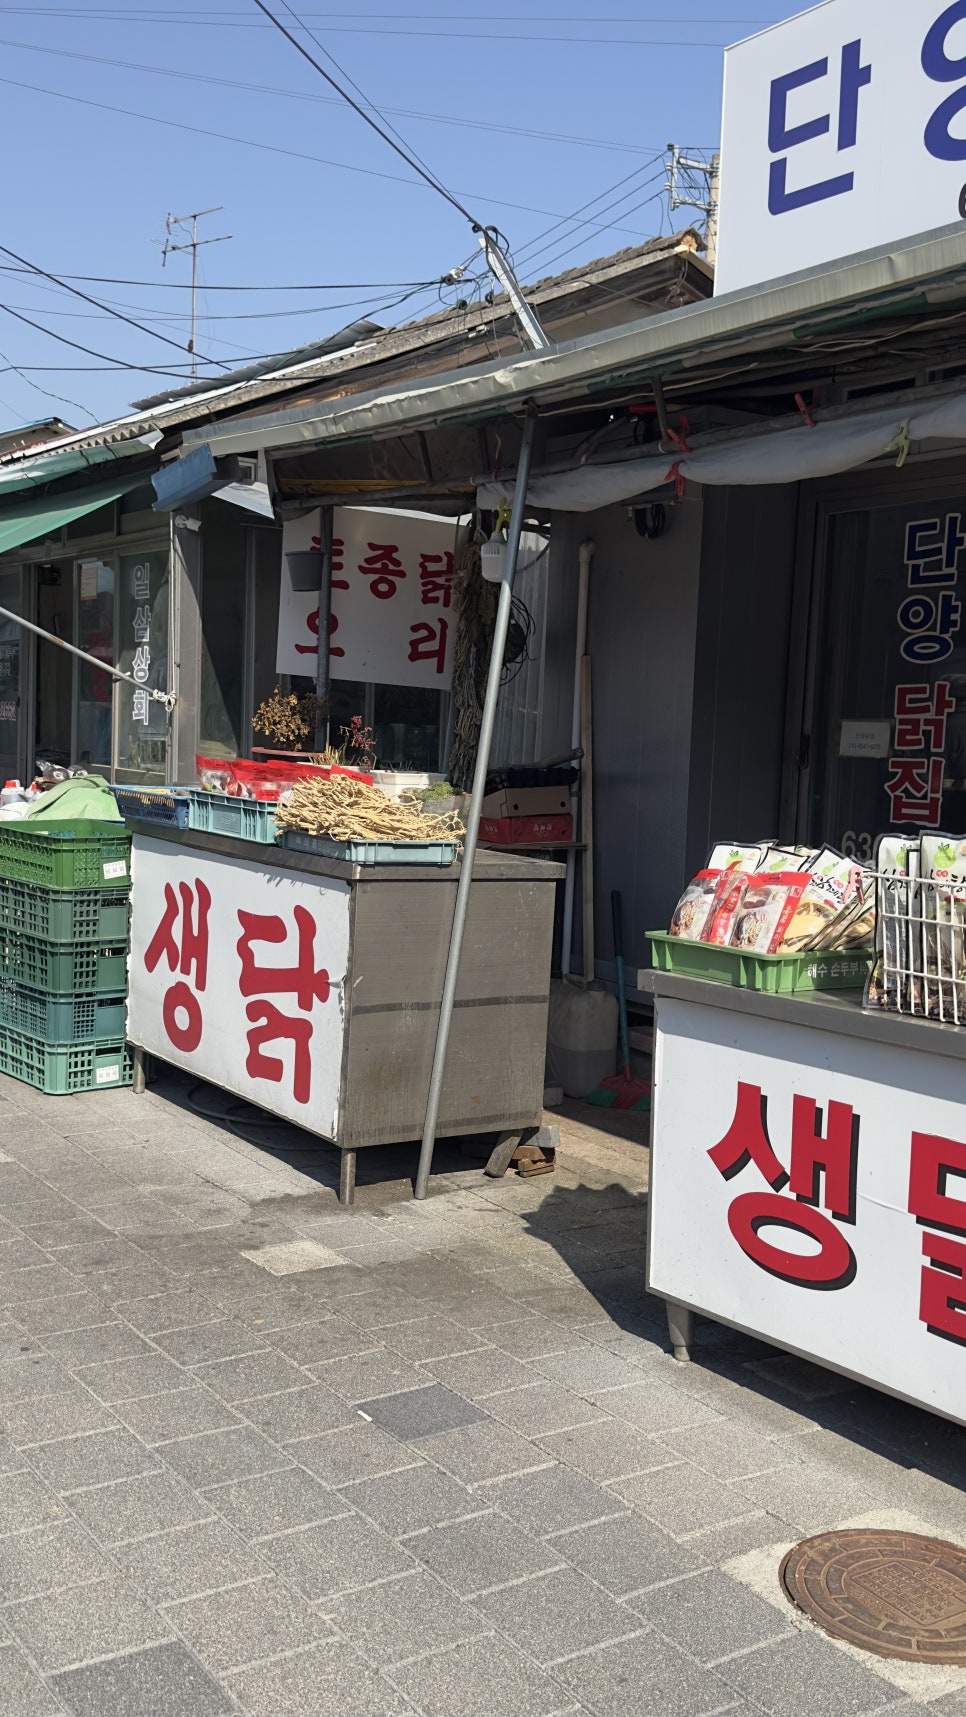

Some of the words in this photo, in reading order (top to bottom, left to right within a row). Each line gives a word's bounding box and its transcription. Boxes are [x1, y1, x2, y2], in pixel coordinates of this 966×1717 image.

[132, 562, 151, 726] 일삼상회
[897, 512, 966, 664] 단양
[884, 681, 956, 827] 닭집
[144, 877, 331, 1105] 생닭
